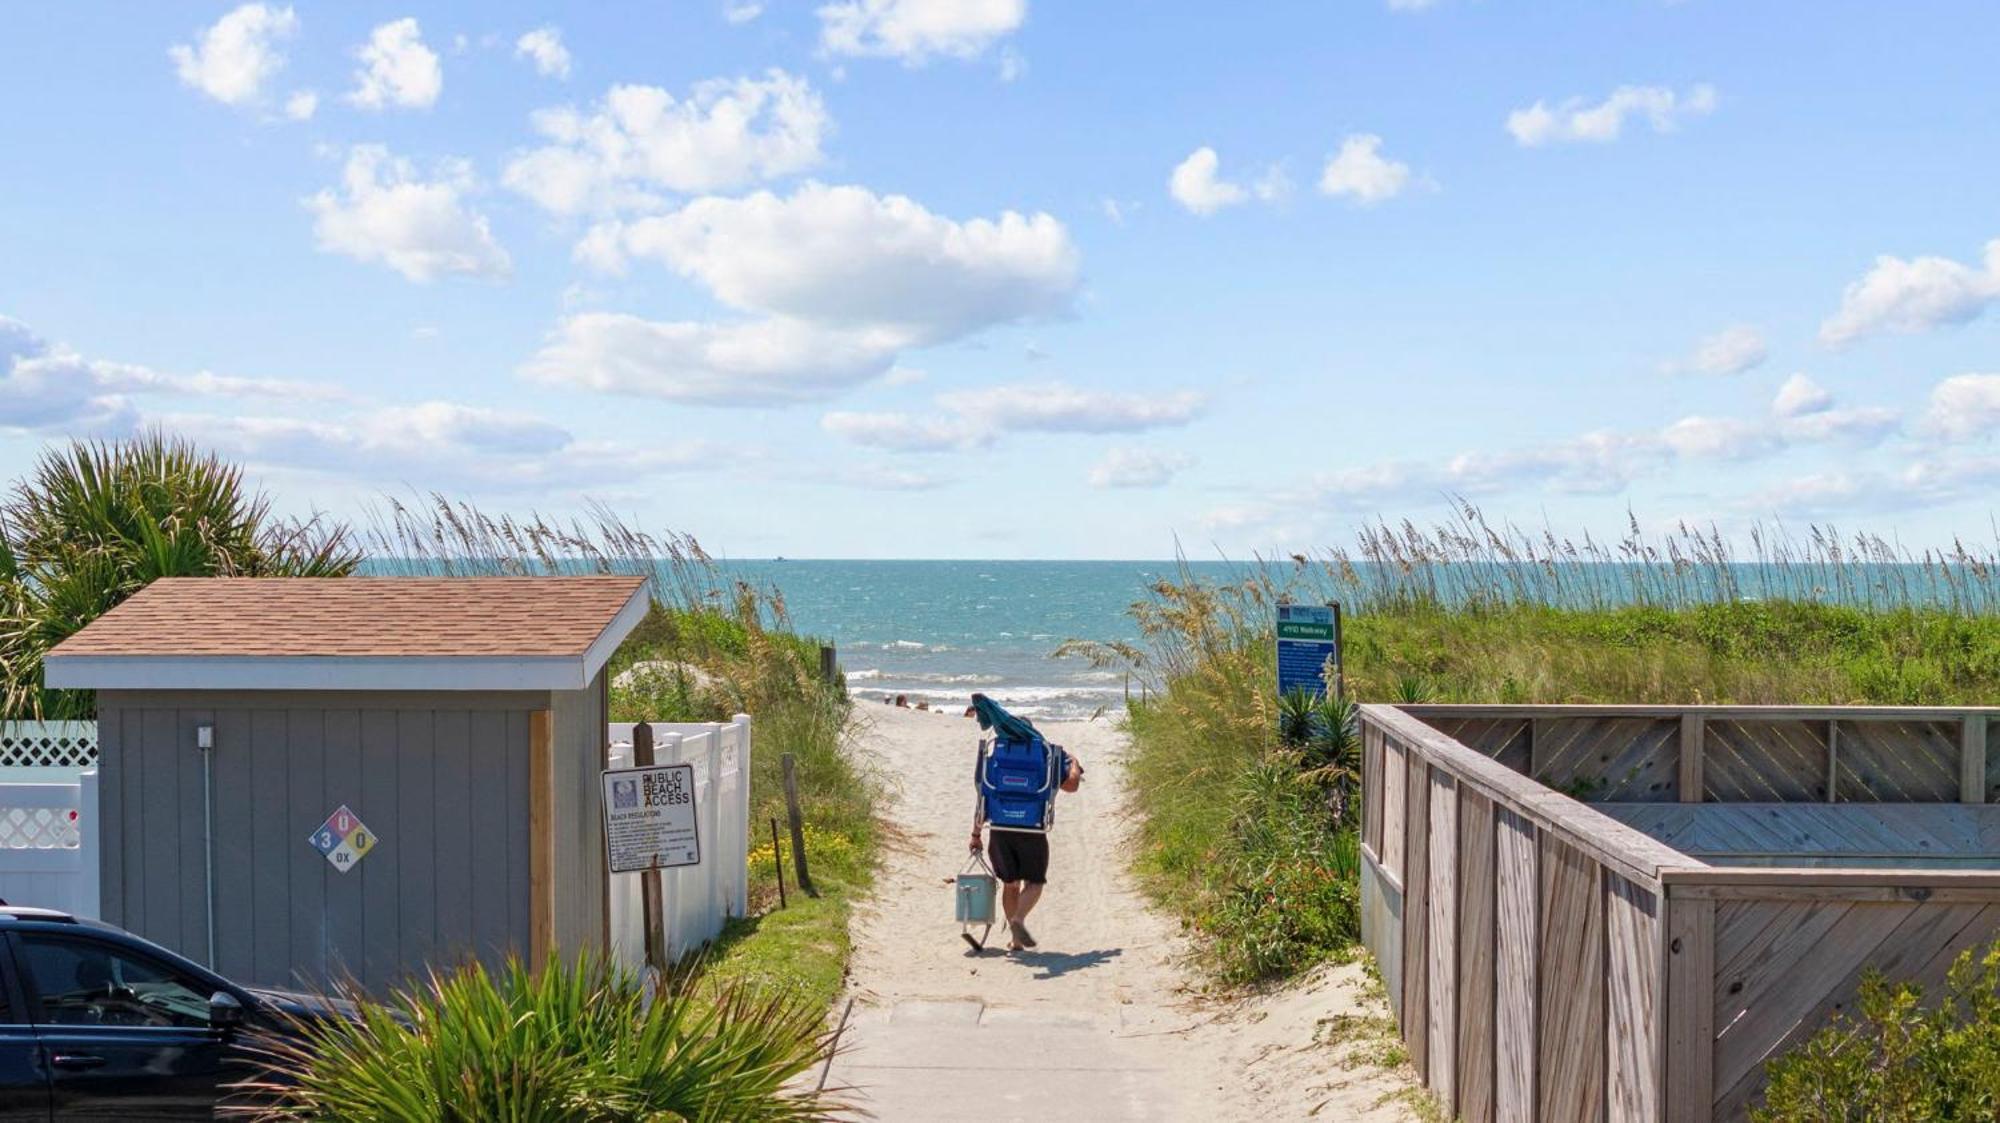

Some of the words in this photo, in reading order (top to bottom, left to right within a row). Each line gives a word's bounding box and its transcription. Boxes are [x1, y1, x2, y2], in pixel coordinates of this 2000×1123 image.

[643, 771, 682, 783] PUBLIC
[644, 782, 682, 796] BEACH
[645, 793, 690, 807] ACCESS
[321, 832, 331, 848] 3
[356, 832, 366, 848] 0
[336, 852, 350, 863] OX
